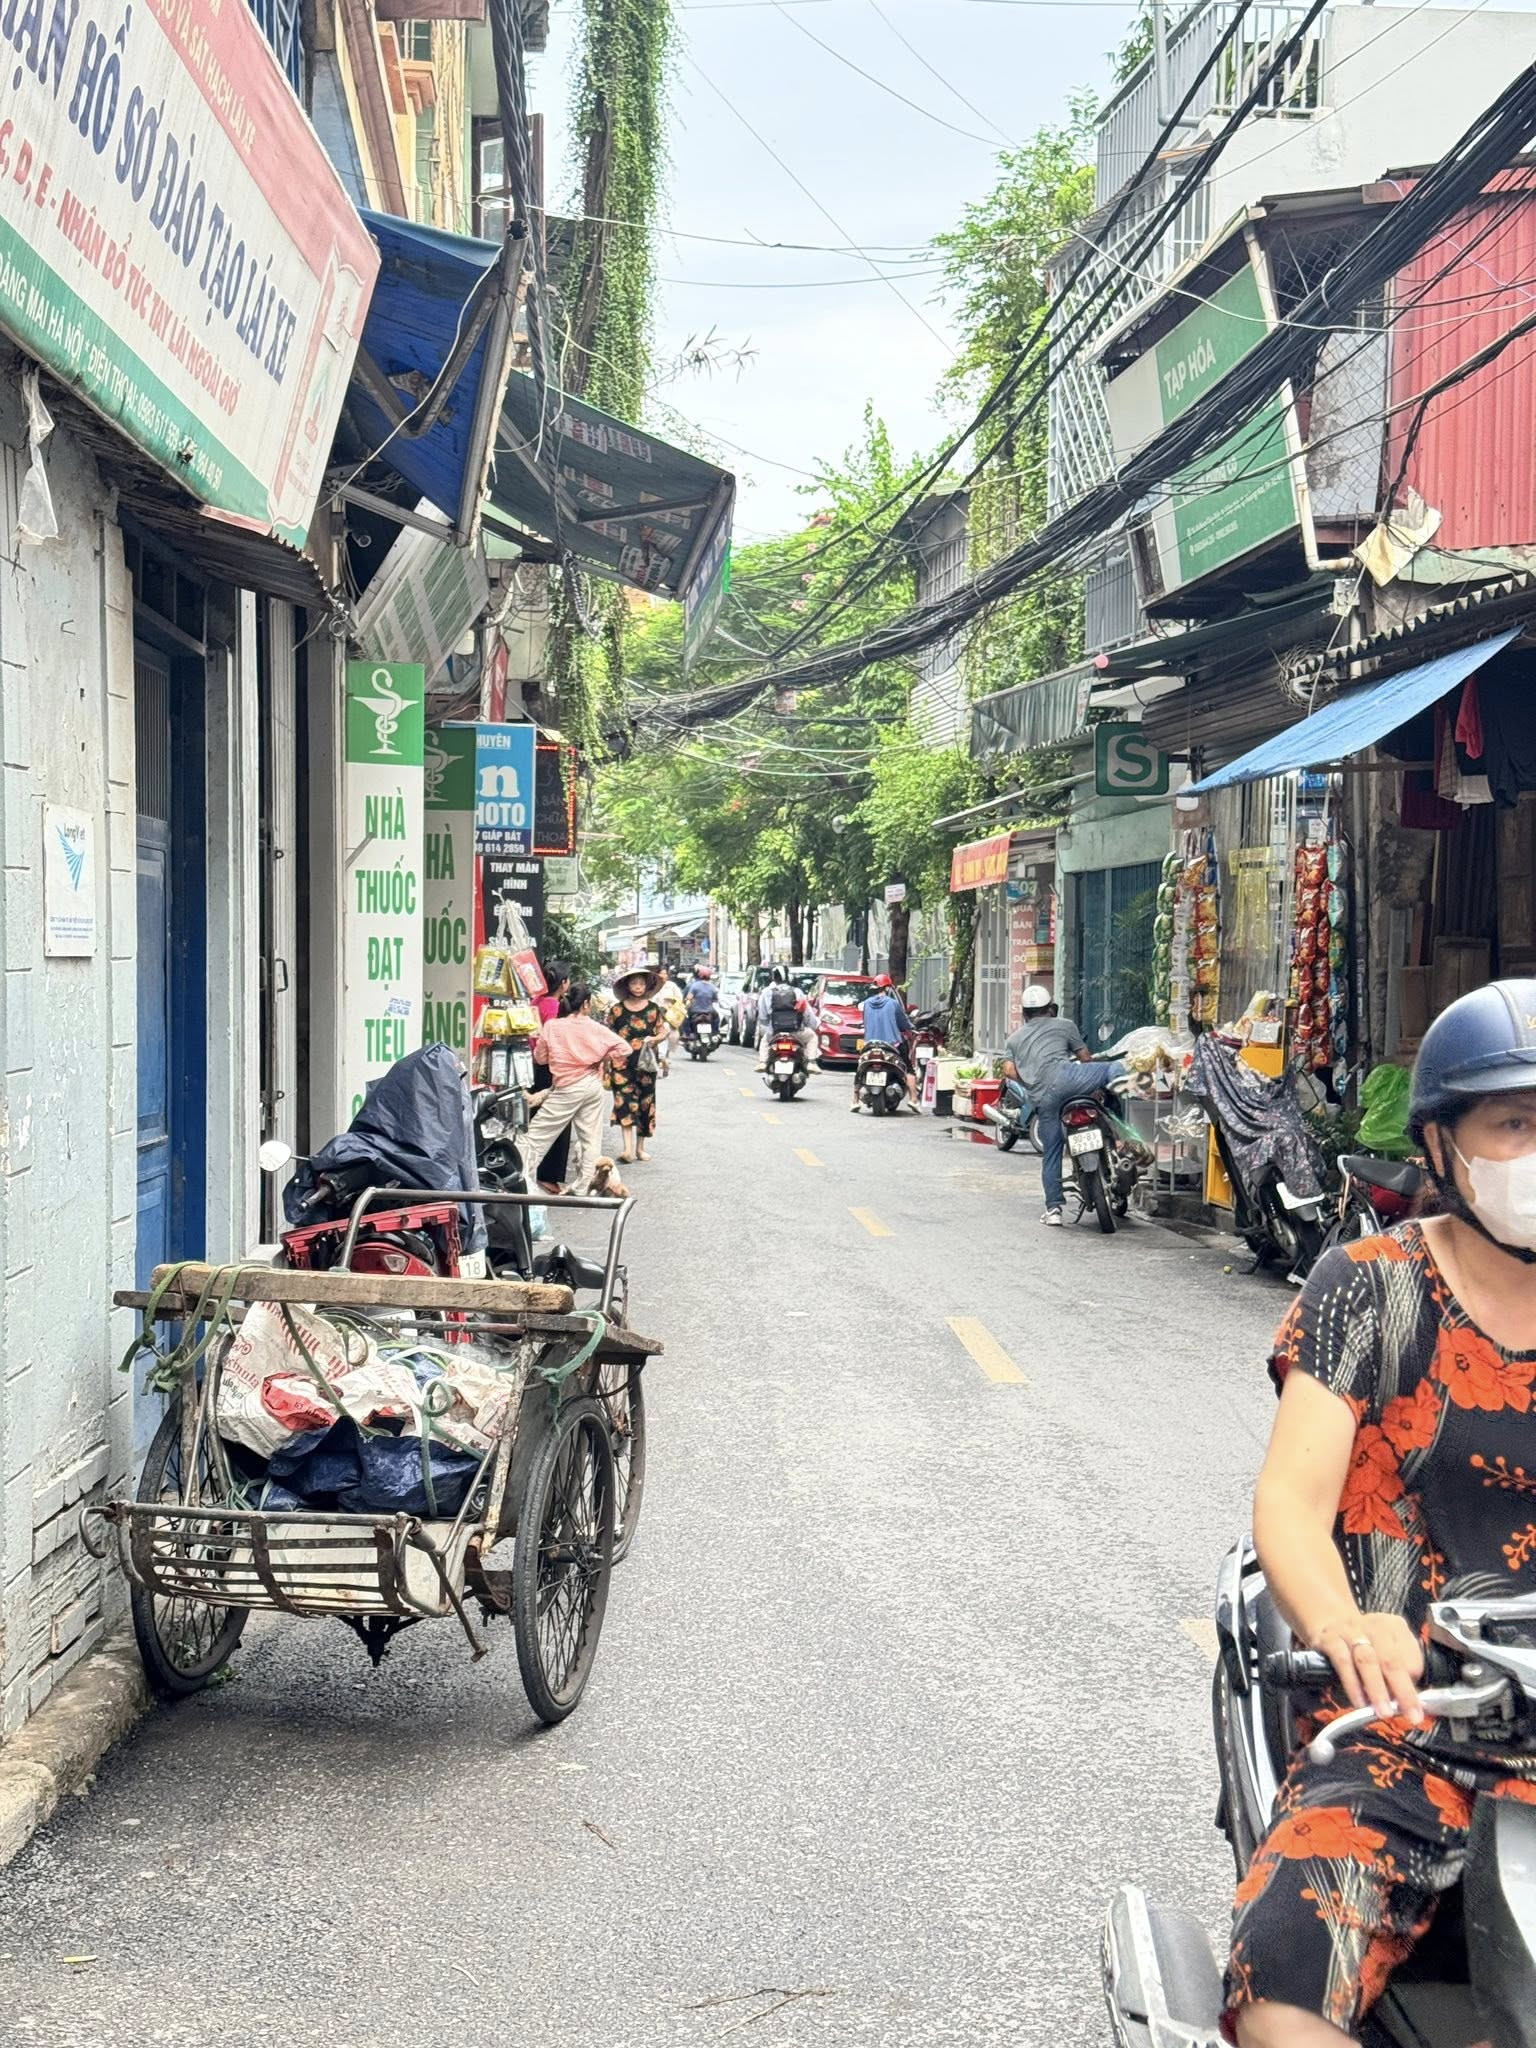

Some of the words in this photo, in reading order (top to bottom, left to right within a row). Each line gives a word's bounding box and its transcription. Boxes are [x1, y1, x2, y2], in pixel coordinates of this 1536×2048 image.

[205, 53, 233, 117] HẠCH
[68, 4, 132, 155] HỒ
[114, 85, 165, 203] SƠ
[149, 132, 206, 268] ĐÀO
[199, 201, 245, 326] TẠO
[235, 253, 276, 359] LÁI
[263, 297, 297, 387] XE
[34, 163, 52, 209] E
[56, 188, 107, 271] NHẬN
[102, 232, 133, 290] BỔ
[125, 264, 153, 320] TÚC
[149, 289, 173, 343] TAY
[168, 308, 193, 363] LÁI
[185, 333, 222, 399] NGOÀI
[26, 283, 49, 330] MAI
[47, 305, 65, 346] HÀ
[64, 321, 84, 367] NỘI
[1163, 362, 1187, 401] TẠP
[1189, 337, 1217, 382] HÓA
[1114, 734, 1154, 783] S
[365, 787, 406, 840] NHÀ
[475, 801, 526, 827] HOTO
[481, 830, 503, 841] GIÁP
[426, 823, 455, 880] HÀ
[490, 862, 514, 873] THAY
[515, 861, 540, 874] MÀN
[355, 854, 416, 915] THUỐC
[503, 877, 528, 890] HÌNH
[424, 900, 466, 965] UỐC
[1013, 918, 1032, 929] BÁN
[367, 936, 404, 991] ĐẠT
[422, 991, 467, 1049] ĂNG
